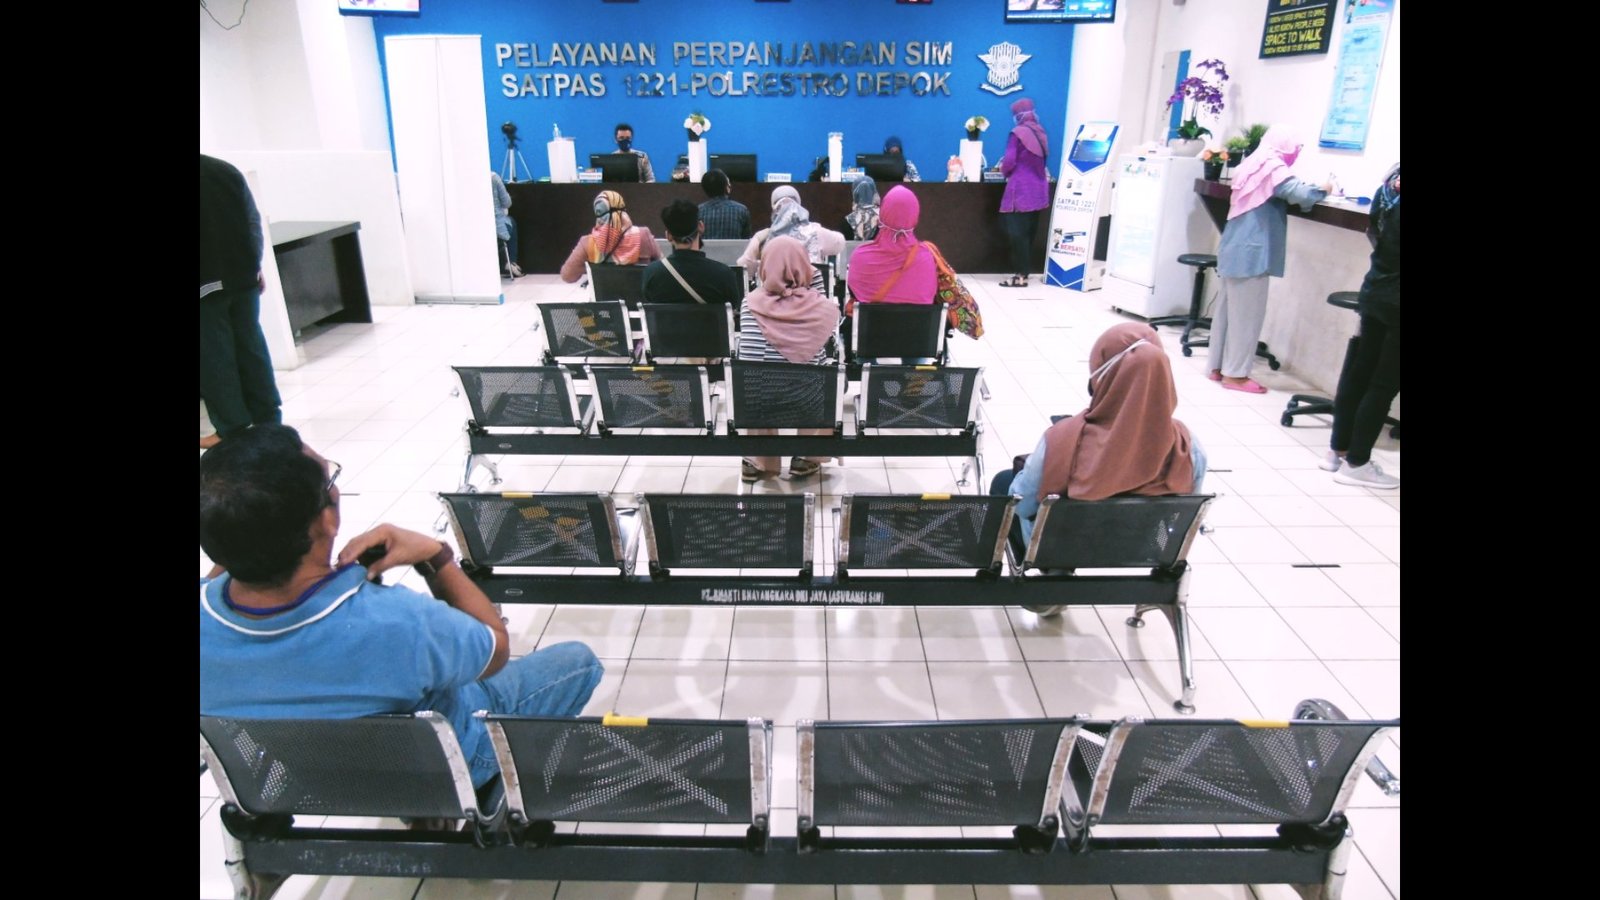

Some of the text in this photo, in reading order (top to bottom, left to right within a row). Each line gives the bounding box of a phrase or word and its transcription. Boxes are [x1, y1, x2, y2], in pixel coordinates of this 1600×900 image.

[1265, 32, 1287, 46] SPACE
[1288, 31, 1298, 43] TO
[496, 41, 953, 68] PELAYANAN PERPANJANGAN SIM
[501, 71, 952, 98] SATPAS 1221-POLRESTRO DEPOK
[1061, 244, 1086, 253] BERSATU
[809, 589, 828, 604] JAYA
